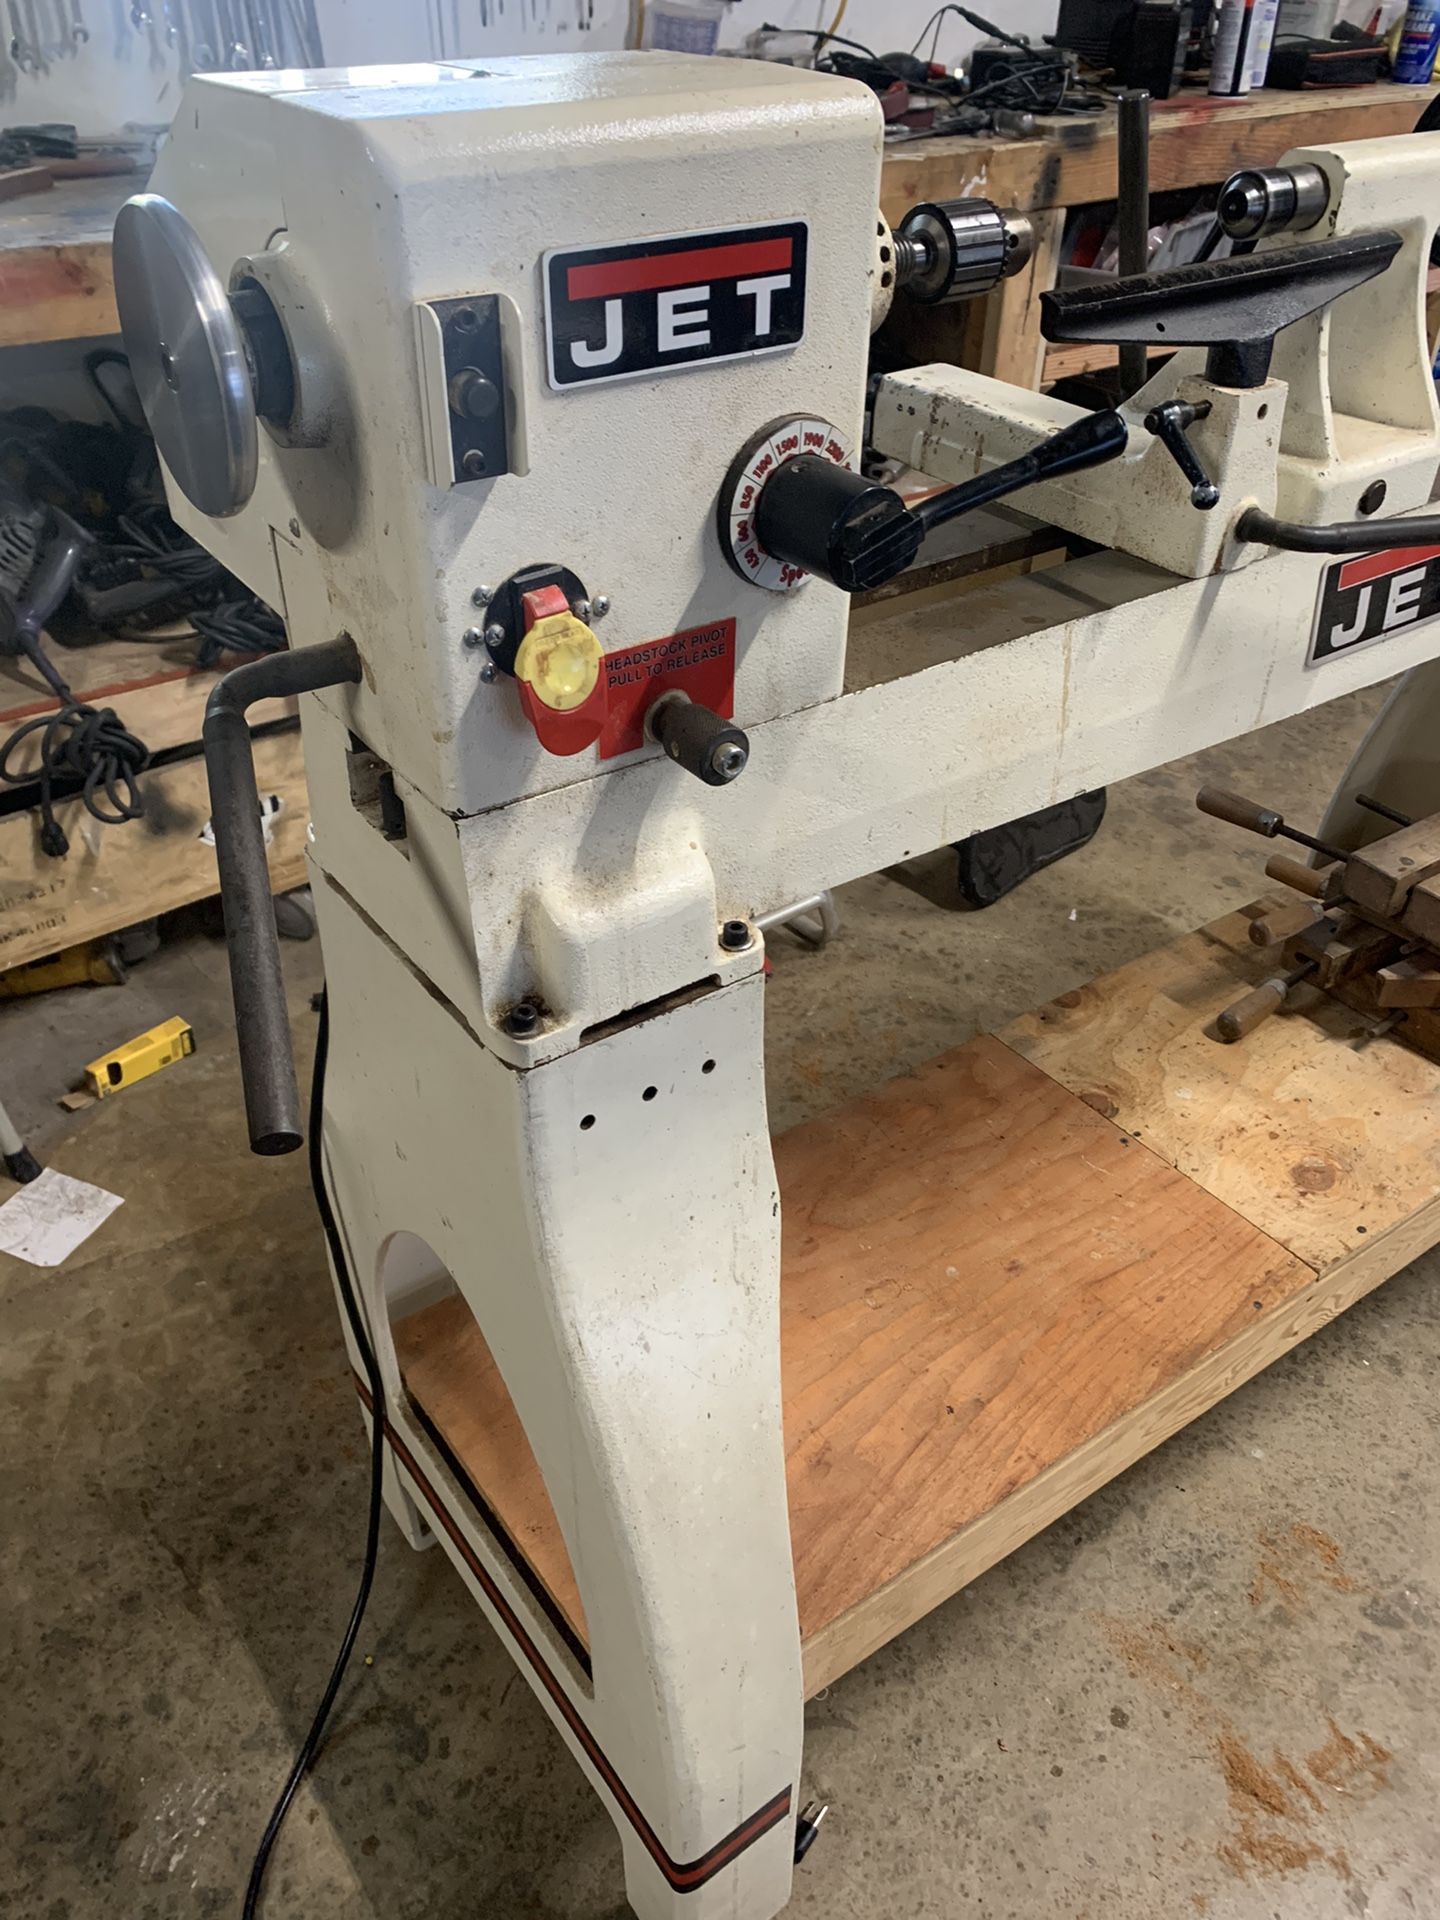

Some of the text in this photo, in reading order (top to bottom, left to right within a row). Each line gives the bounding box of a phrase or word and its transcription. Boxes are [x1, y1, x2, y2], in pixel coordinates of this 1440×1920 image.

[570, 273, 792, 369] JET
[775, 434, 799, 457] 1500
[803, 431, 825, 448] 1900
[752, 453, 774, 479] 1100
[739, 484, 755, 510] 850
[778, 563, 811, 588] Spe
[1330, 565, 1428, 648] JE
[604, 626, 728, 673] HEADSTOCK PIVOT
[607, 642, 726, 689] PULL TO RELEASE
